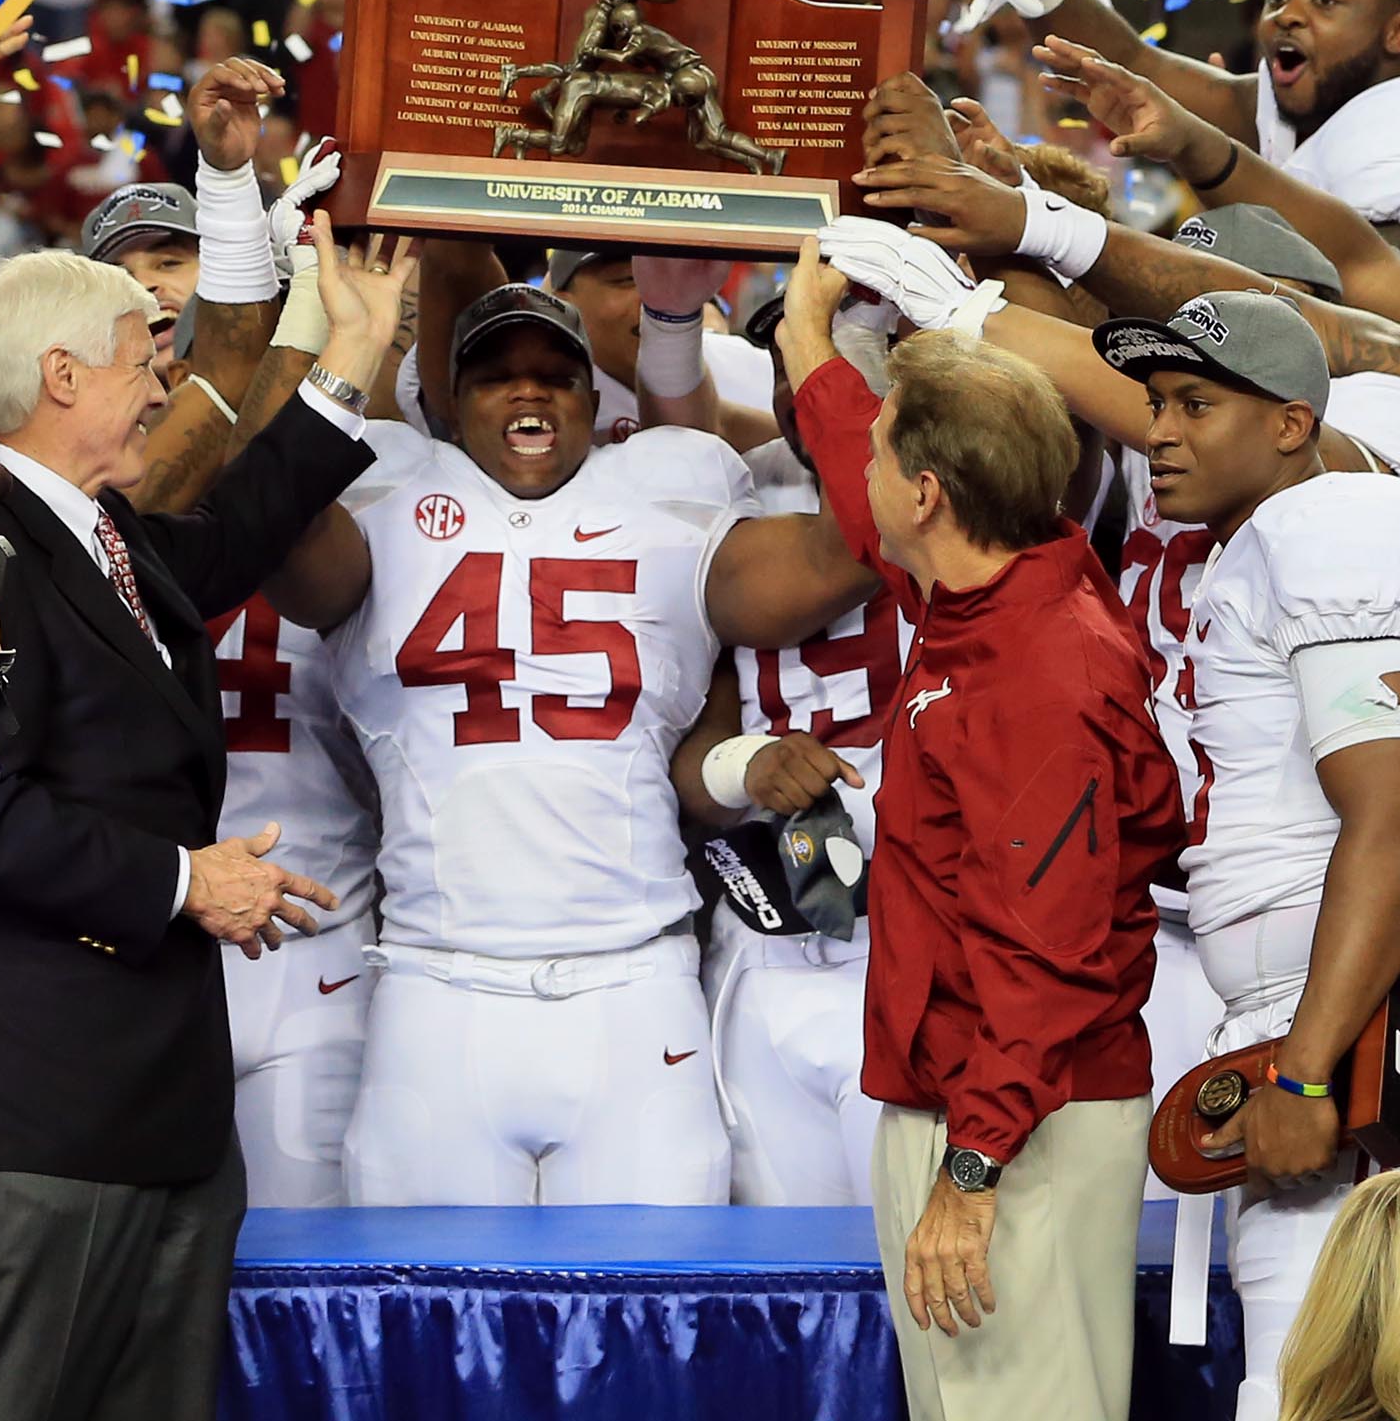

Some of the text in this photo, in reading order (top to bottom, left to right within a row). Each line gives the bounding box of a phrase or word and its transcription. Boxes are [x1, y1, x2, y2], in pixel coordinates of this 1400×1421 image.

[414, 14, 524, 34] UNIVERSITY OF ALABAMA
[410, 30, 525, 50] UNIVERSITY OF ARKANSAS
[756, 40, 857, 50] UNIVERSITY OF MISSISSIPPI
[421, 48, 511, 64] AUBURN UNIVERSITY
[749, 56, 862, 67] MISSISSIPPI STATE UNIVERSITY
[412, 63, 464, 77] UNIVERSITY
[466, 69, 478, 78] OF
[757, 72, 851, 83] UNIVERSITY OF MISSOURI
[410, 80, 462, 93] UNIVERSITY
[464, 85, 477, 94] OF
[742, 89, 865, 100] UNIVERSITY OF SOUTH CAROLINA
[405, 95, 521, 115] UNIVERSITY OF KENTUCKY
[752, 105, 852, 116] UNIVERSITY OF TENNESSEE
[397, 111, 445, 124] LOUISIANA
[446, 115, 473, 126] STATE
[757, 121, 846, 132] TEXAS A&M UNIVERSITY
[801, 138, 846, 148] UNIVERSITY
[487, 182, 723, 211] UNIVERSITY OF ALABAMA
[561, 203, 645, 218] 2014 CHAMPION
[1105, 342, 1203, 368] CHAMPIONS
[416, 495, 464, 540] SEC
[397, 551, 643, 747] 45
